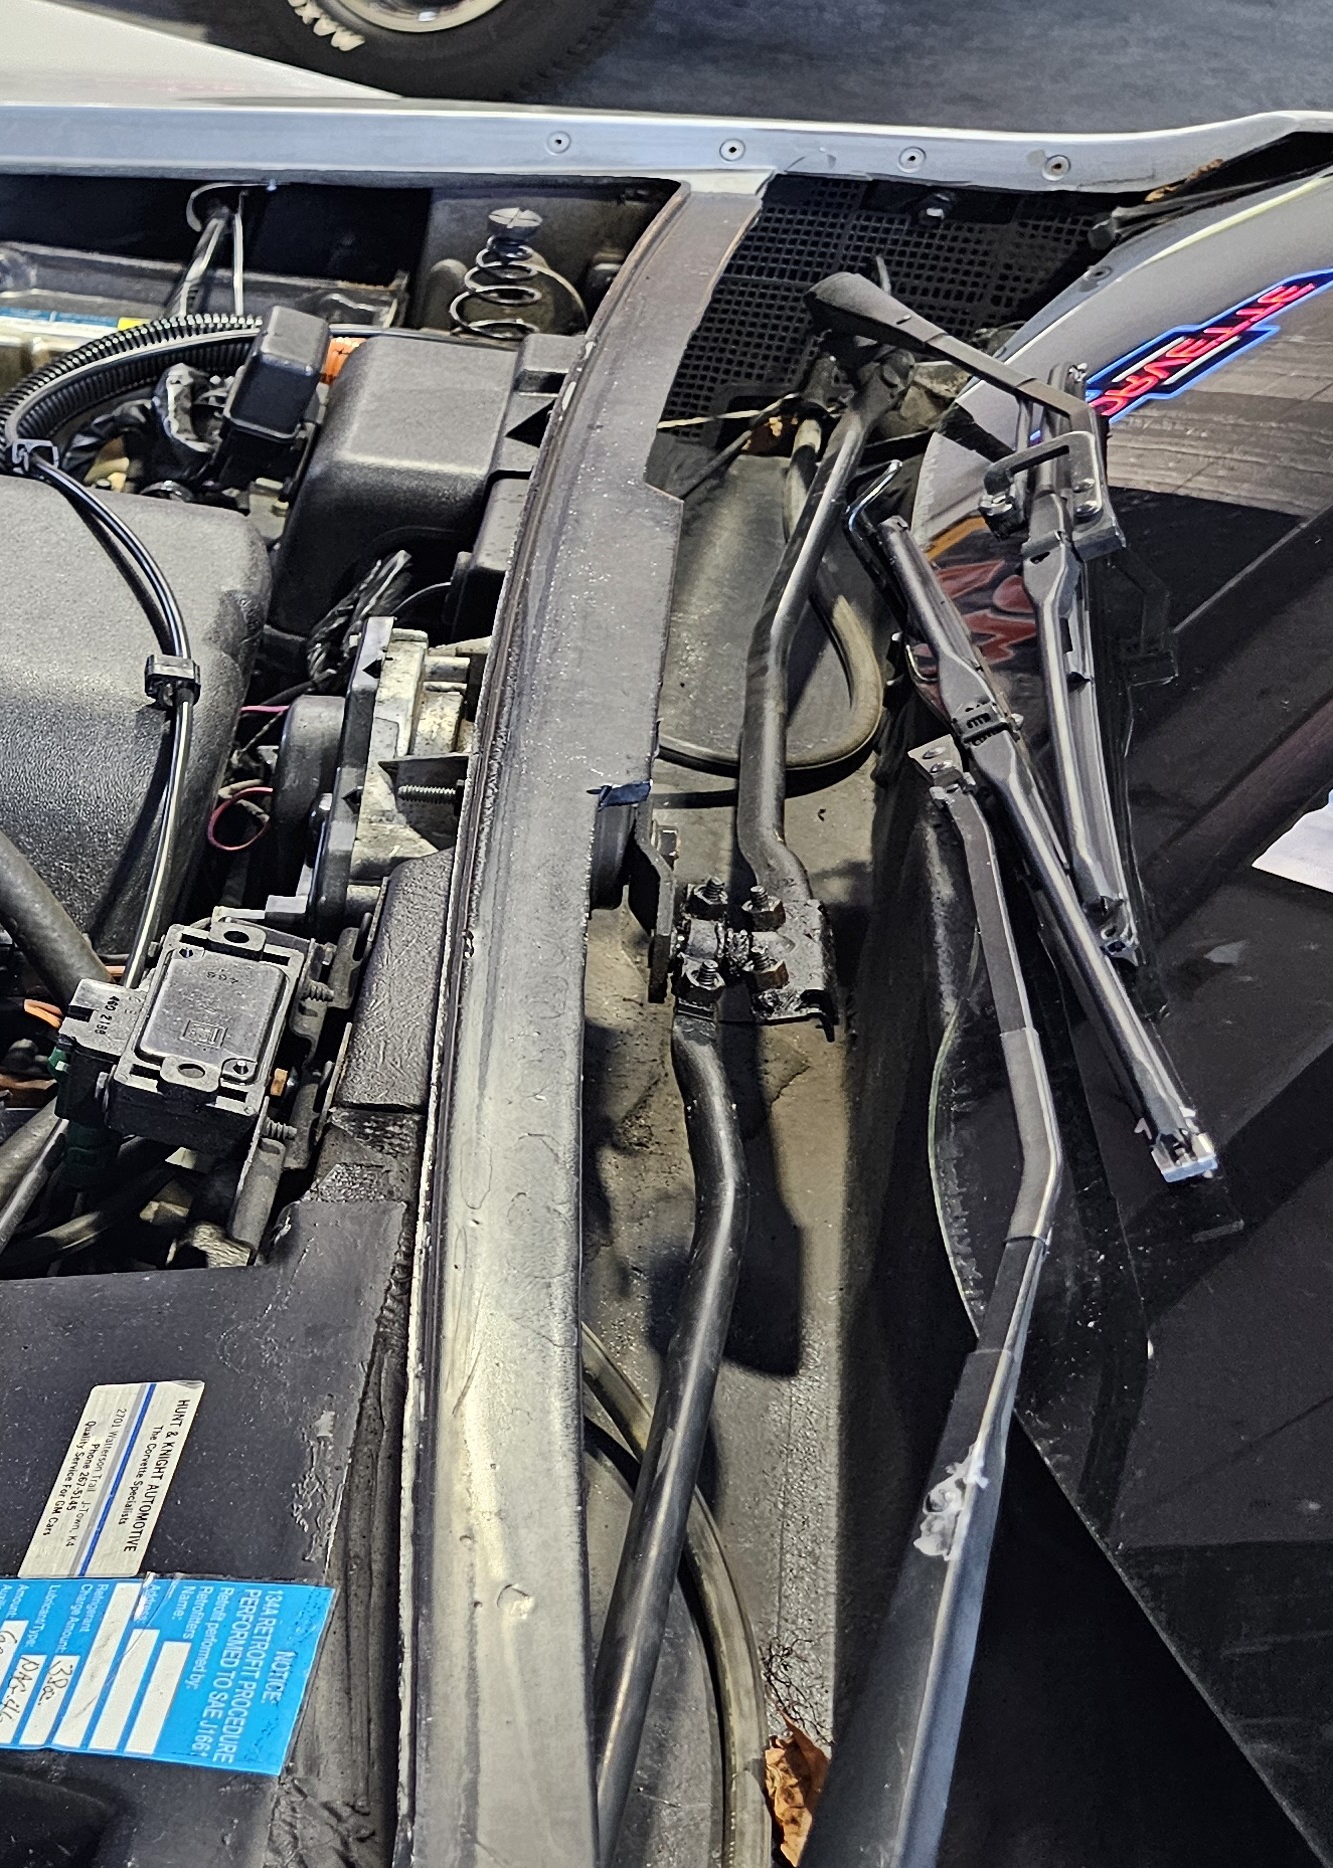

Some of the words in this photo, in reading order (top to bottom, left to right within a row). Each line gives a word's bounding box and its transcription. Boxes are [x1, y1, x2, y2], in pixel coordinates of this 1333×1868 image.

[110, 1408, 127, 1427] 2701
[169, 1399, 190, 1427] HUNT
[75, 1420, 97, 1448] Quality
[149, 1425, 163, 1440] The
[64, 1452, 84, 1481] Service
[81, 1443, 100, 1469] Phone
[135, 1443, 156, 1478] Corvette
[149, 1441, 174, 1480] KNIGHT
[57, 1484, 71, 1497] For
[65, 1471, 89, 1510] 267-5145
[85, 1475, 102, 1492] Trail
[50, 1500, 64, 1513] GM
[68, 1500, 91, 1532] J-Town,
[116, 1480, 143, 1524] Specialists
[122, 1484, 159, 1552] AUTOMOTIVE
[41, 1517, 58, 1535] Cars
[3, 1584, 30, 1618] Amount:
[22, 1584, 61, 1648] Lubricant/Type:
[67, 1583, 93, 1615] Charge
[74, 1583, 108, 1632] Refrigerant
[170, 1586, 196, 1620] Name:
[180, 1585, 213, 1639] Retrofitters
[208, 1587, 234, 1621] Retrofit
[258, 1589, 284, 1616] 134A
[54, 1616, 79, 1653] Amount:
[218, 1589, 262, 1667] PERFORMED
[188, 1622, 222, 1672] performed
[238, 1617, 277, 1677] RETROFIT
[182, 1673, 205, 1689] by:
[211, 1670, 235, 1688] TO
[258, 1650, 295, 1705] NOTICE:
[201, 1690, 228, 1718] SAE
[211, 1682, 256, 1763] PROCEDURE
